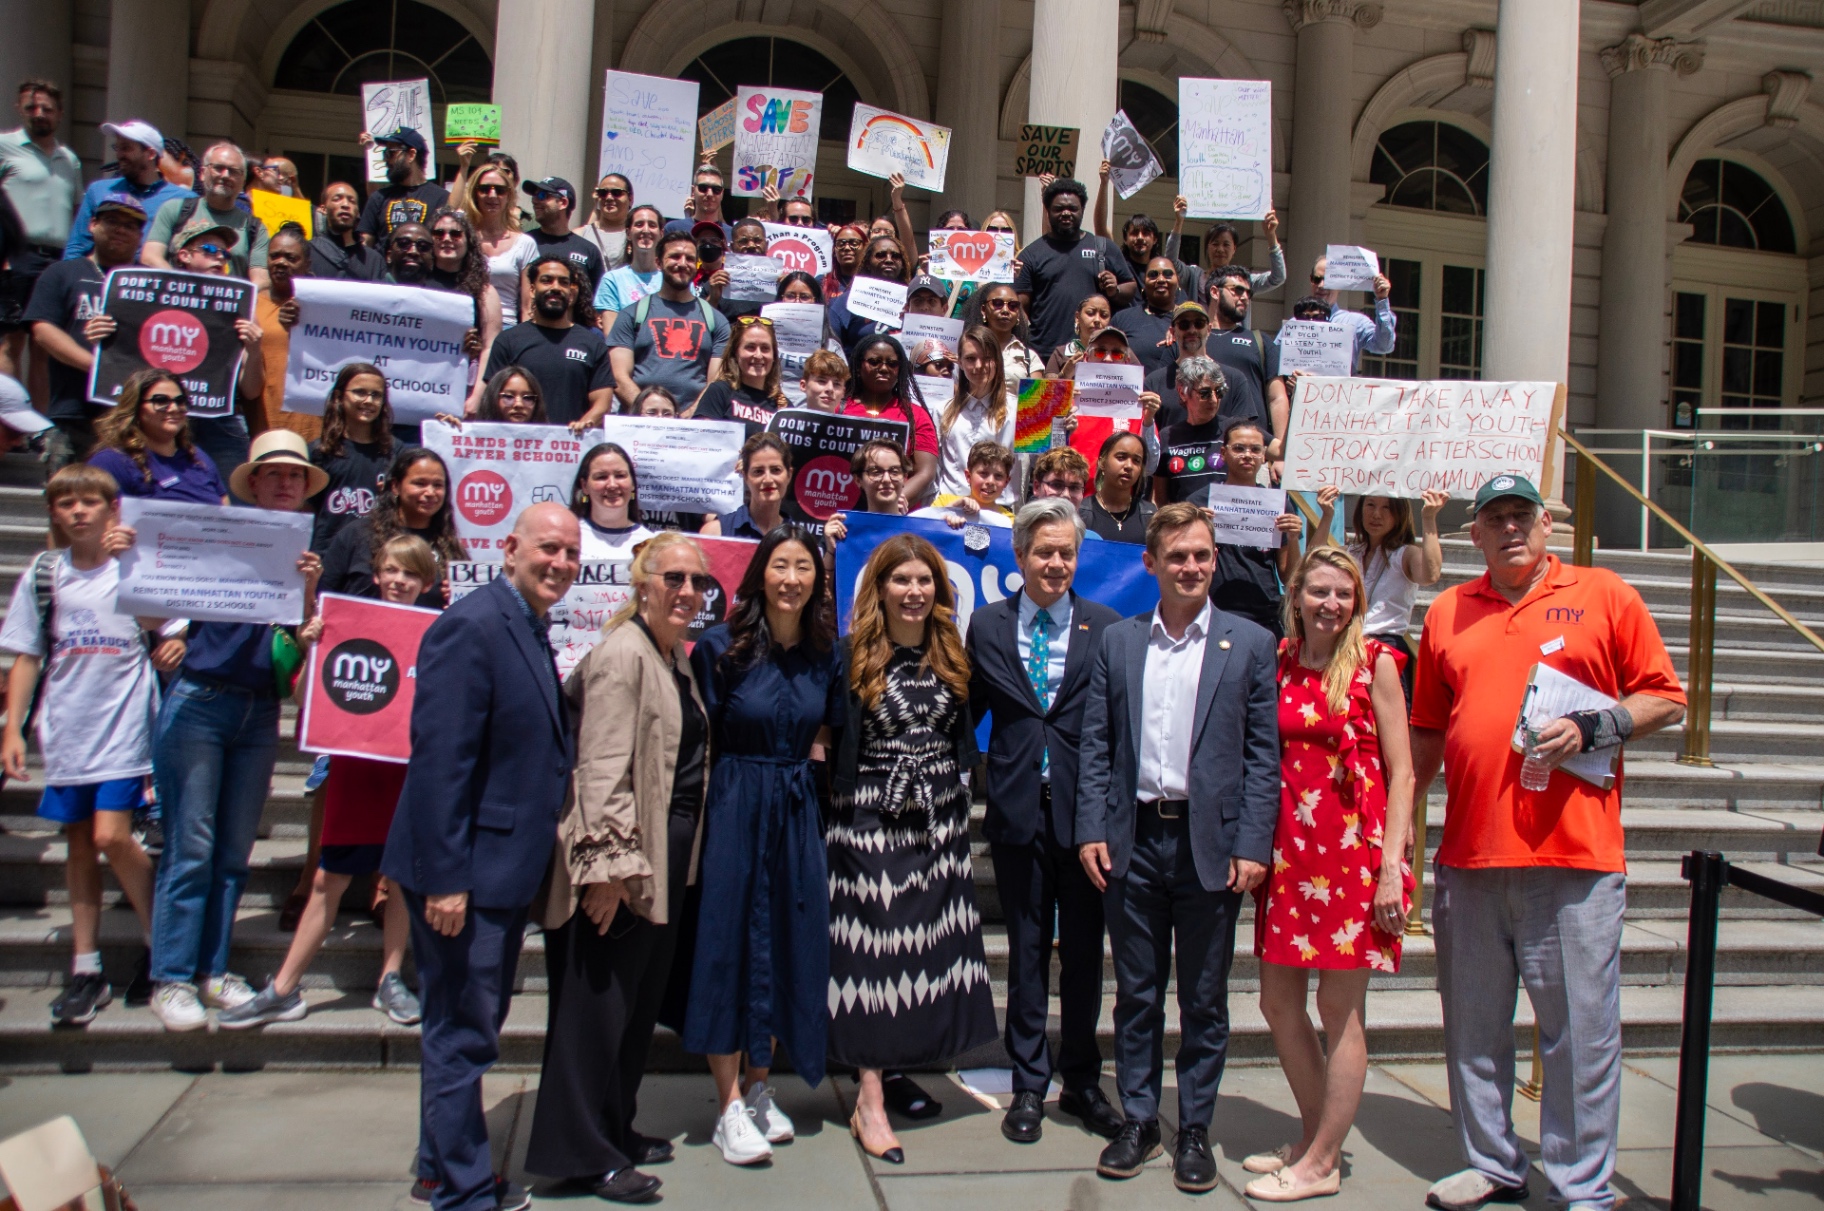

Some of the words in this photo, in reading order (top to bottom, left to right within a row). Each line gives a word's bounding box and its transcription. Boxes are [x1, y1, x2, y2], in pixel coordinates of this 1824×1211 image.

[743, 93, 813, 134] SAVE
[1021, 124, 1073, 145] SAVE
[1184, 119, 1245, 146] Manhattan
[740, 132, 812, 153] MANHATTAN
[1027, 139, 1062, 160] OUR
[604, 144, 634, 161] AND
[641, 149, 667, 170] SO
[737, 151, 776, 166] YOUTH
[777, 152, 807, 168] AND
[1015, 156, 1074, 179] SPORTS
[738, 164, 813, 196] STAFF!
[767, 231, 791, 242] Than
[801, 234, 828, 269] Program
[118, 276, 163, 290] DON'T
[166, 281, 197, 294] CUT
[202, 285, 245, 300] WHAT
[119, 289, 155, 303] KIDS
[161, 294, 209, 310] COUNT
[213, 301, 239, 313] ON!
[350, 309, 424, 329] REINSTATE
[905, 331, 939, 340] MANHATTAN
[1286, 324, 1298, 332] PUT
[303, 323, 406, 349] MANHATTAN
[408, 337, 461, 356] YOUTH
[150, 344, 198, 356] manhattan
[161, 352, 187, 363] youth
[1297, 347, 1322, 357] YOUTH!
[372, 355, 391, 367] AT
[385, 377, 451, 396] SCHOOLS!
[1079, 381, 1118, 389] MANHATTAN
[1302, 382, 1380, 407] DON'T
[1395, 386, 1452, 410] TAKE
[1459, 388, 1539, 410] AWAY
[778, 418, 821, 434] DON'T
[826, 425, 855, 439] CUT
[1300, 408, 1451, 432] MANHATTAN
[1466, 412, 1549, 436] YOUTH
[452, 435, 507, 448] HANDS
[513, 438, 544, 450] OFF
[550, 440, 582, 452] OUR
[779, 432, 813, 447] KIDS
[453, 448, 506, 461] AFTER
[512, 451, 579, 464] SCHOOL!
[1168, 446, 1207, 457] Wagner
[1296, 437, 1400, 462] STRONG
[1414, 439, 1544, 463] AFTERSCHOOL
[1172, 460, 1179, 470] 1
[1192, 458, 1201, 469] 6
[1211, 455, 1221, 467] 7
[1317, 466, 1396, 490] STRONG
[639, 493, 670, 501] DISTRICT
[650, 484, 700, 494] MANHATTAN
[700, 487, 727, 496] YOUTH
[804, 489, 849, 502] manhattan
[464, 501, 504, 510] manhattan
[814, 499, 838, 509] youth
[1231, 498, 1263, 506] REINSTATE
[474, 507, 496, 518] youth
[1213, 505, 1256, 515] MANHATTAN
[1256, 509, 1280, 517] YOUTH
[1213, 522, 1240, 531] DISTRICT
[1244, 526, 1275, 534] SCHOOLS!
[459, 538, 491, 550] AVE
[133, 586, 179, 596] REINSTATE
[181, 588, 241, 599] MANHATTAN
[243, 590, 276, 600] YOUTH
[593, 591, 630, 604] YMCA
[166, 599, 206, 608] DISTRICT
[206, 601, 212, 609] 2
[213, 601, 256, 610] SCHOOLS!
[81, 636, 130, 648] BARUCH
[333, 679, 388, 694] manhattan
[345, 690, 374, 702] youth
